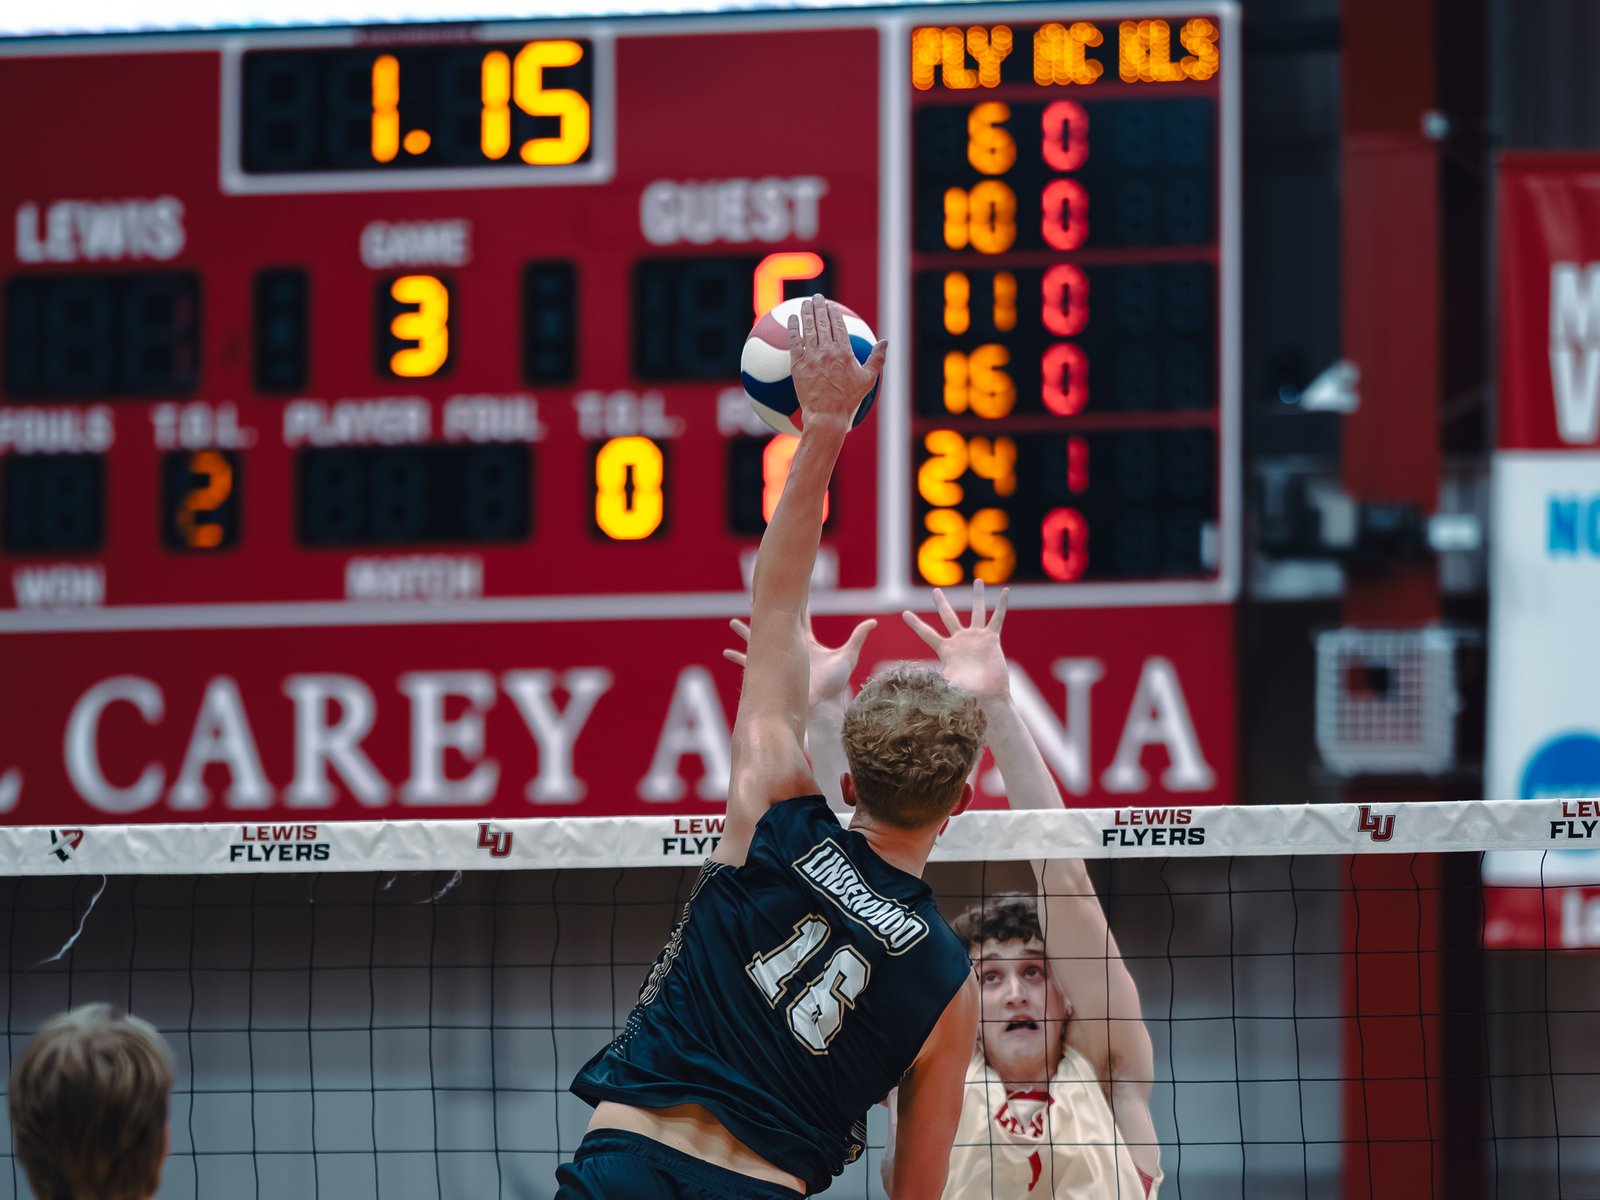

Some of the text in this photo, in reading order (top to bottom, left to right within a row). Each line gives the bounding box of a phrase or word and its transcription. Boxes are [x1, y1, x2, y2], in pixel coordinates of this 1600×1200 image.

[967, 100, 1090, 175] 6 0
[15, 196, 186, 263] LEWIS
[360, 219, 472, 268] GAME
[640, 176, 829, 246] GUEST
[944, 178, 1090, 254] 10 0
[390, 275, 449, 377] 3
[944, 263, 1090, 336] 11 0
[944, 342, 1090, 419] 16 0
[283, 398, 432, 447] PLAYER
[176, 451, 232, 547] 2
[596, 436, 663, 539] 0
[918, 429, 1090, 507] 24 1
[345, 553, 483, 602] MATCH
[918, 508, 1017, 586] 25
[1041, 507, 1090, 582] 0
[63, 666, 614, 814] CAREY
[230, 844, 329, 862] FLYERS
[242, 825, 317, 841] LEWIS
[477, 823, 513, 858] LU
[1102, 827, 1205, 846] FLYERS
[1114, 809, 1192, 826] LEWIS
[1358, 805, 1396, 842] LU
[745, 913, 872, 1056] 16
